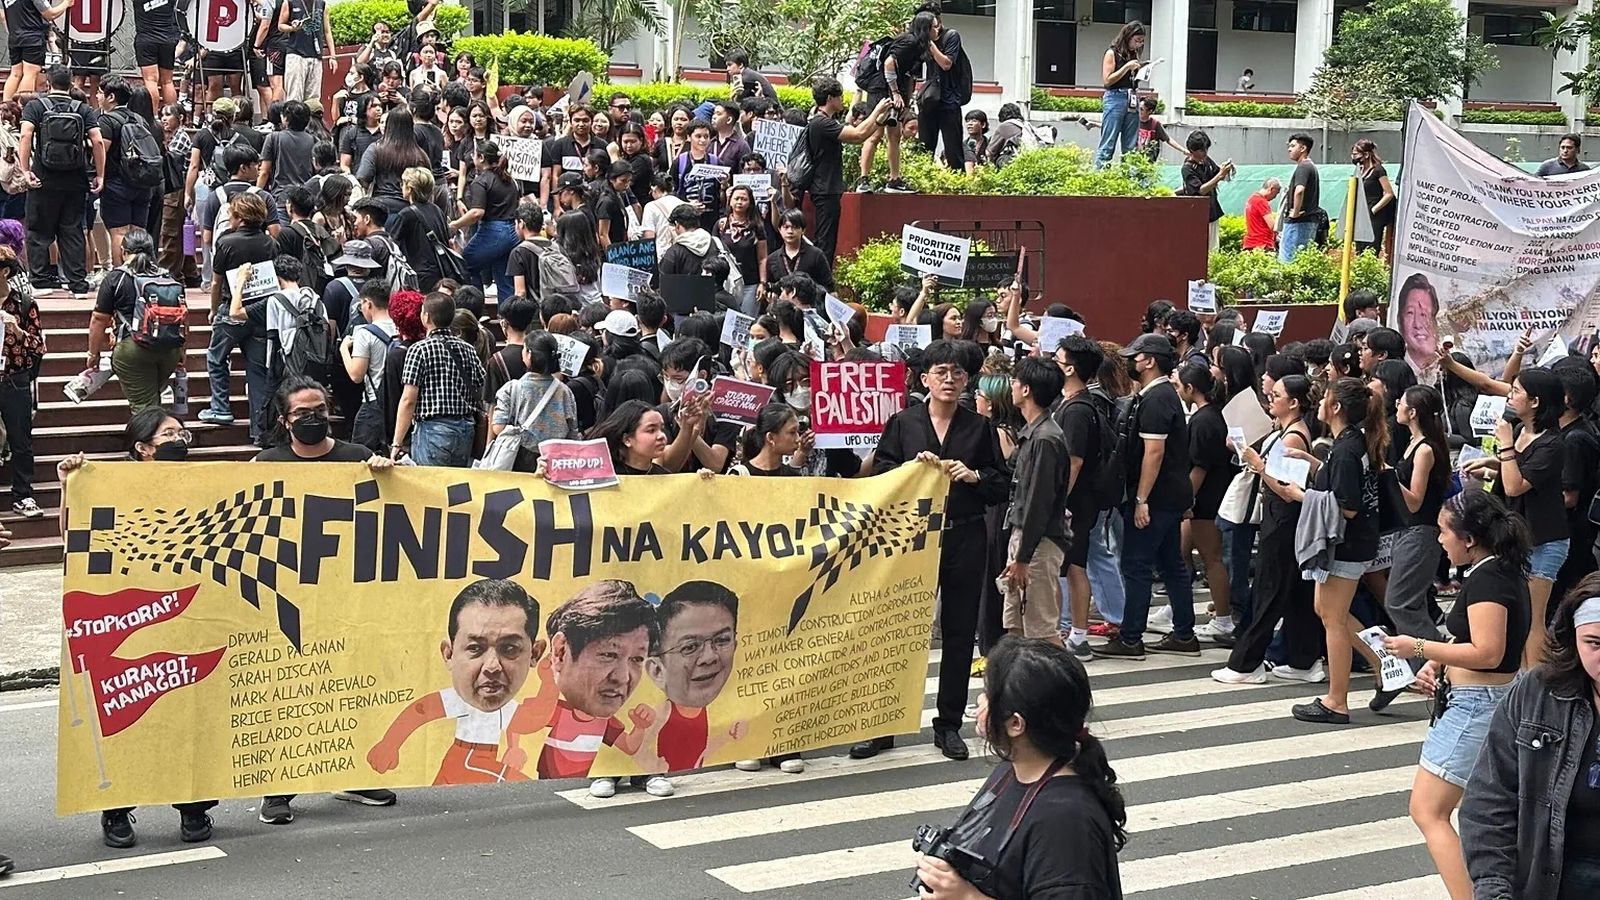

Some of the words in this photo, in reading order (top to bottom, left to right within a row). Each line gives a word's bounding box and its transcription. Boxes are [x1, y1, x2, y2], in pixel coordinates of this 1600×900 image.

[760, 120, 776, 137] THIS
[778, 122, 788, 138] IS
[496, 136, 517, 148] JUST
[756, 135, 788, 154] WHERE
[510, 164, 534, 176] NOW
[1436, 186, 1449, 195] OF
[1483, 180, 1514, 195] THANK
[1514, 188, 1532, 198] YOU
[1534, 190, 1554, 199] TAX
[1497, 194, 1536, 209] WHERE
[1536, 199, 1572, 209] YOUR
[1573, 194, 1600, 205] TAX
[1426, 216, 1460, 231] STARTED
[1430, 206, 1442, 214] OF
[1442, 209, 1499, 231] CONTRACTOR
[906, 242, 961, 263] EDUCATION
[909, 233, 961, 253] PRIORITIZE
[1440, 241, 1460, 252] COST
[1442, 232, 1494, 250] COMPLETION
[1494, 243, 1514, 254] DATE
[918, 255, 943, 268] NOW
[1406, 252, 1431, 266] SOURCE
[1440, 262, 1458, 273] FUND
[1451, 254, 1477, 267] OFFICE
[1543, 265, 1575, 274] BAYAN
[820, 361, 895, 393] FREE
[714, 397, 740, 409] SPACES
[725, 391, 757, 404] STUDENT
[815, 391, 904, 426] PALESTINE
[551, 458, 586, 471] DEFEND
[588, 457, 604, 469] UP!
[602, 521, 663, 563] NA
[681, 518, 806, 564] KAYO!
[850, 592, 881, 607] ALPHA
[893, 575, 923, 594] OMEGA
[65, 592, 179, 638] #STOPKORAP!
[800, 608, 874, 631] CONSTRUCTION
[877, 590, 936, 615] CORPORATION
[228, 629, 269, 648] DPWH
[744, 646, 768, 662] WAY
[769, 638, 804, 656] MAKER
[808, 631, 854, 648] GENERAL
[858, 610, 909, 637] CONTRACTOR
[913, 606, 931, 620] OPC
[228, 648, 281, 668] GERALD
[737, 667, 753, 680] YPR
[784, 648, 847, 671] CONTRACTOR
[850, 641, 867, 655] AND
[870, 624, 931, 648] CONSTRUCTIO
[100, 656, 188, 694] KURAKOT
[229, 669, 271, 688] SARAH
[277, 660, 332, 680] DISCAYA
[737, 681, 768, 698] ELITE
[799, 657, 862, 685] CONTRACTORS
[862, 650, 879, 666] AND
[780, 685, 826, 706] MATTHEW
[853, 659, 908, 684] CONTRACTOR
[103, 667, 197, 716] MANAGOT!
[230, 691, 267, 708] MARK
[272, 683, 314, 702] ALLAN
[319, 675, 376, 695] AREVALO
[775, 705, 807, 724] GREAT
[809, 692, 851, 713] PACIFIC
[851, 678, 896, 701] BUILDERS
[231, 710, 272, 728] BRICE
[278, 699, 333, 720] ERICSON
[340, 688, 414, 712] FERNANDEZ
[787, 714, 830, 735] GERRARD
[833, 693, 900, 720] CONSTRUCTION
[231, 727, 302, 748] ABELARDO
[308, 717, 357, 735] CALALO
[764, 735, 812, 757] AMETHYST
[814, 723, 857, 743] HORIZON
[861, 707, 906, 729] BUILDERS
[232, 748, 275, 768] HENRY
[279, 736, 355, 760] ALCANTARA
[233, 768, 276, 788] HENRY
[280, 756, 356, 781] ALCANTARA
